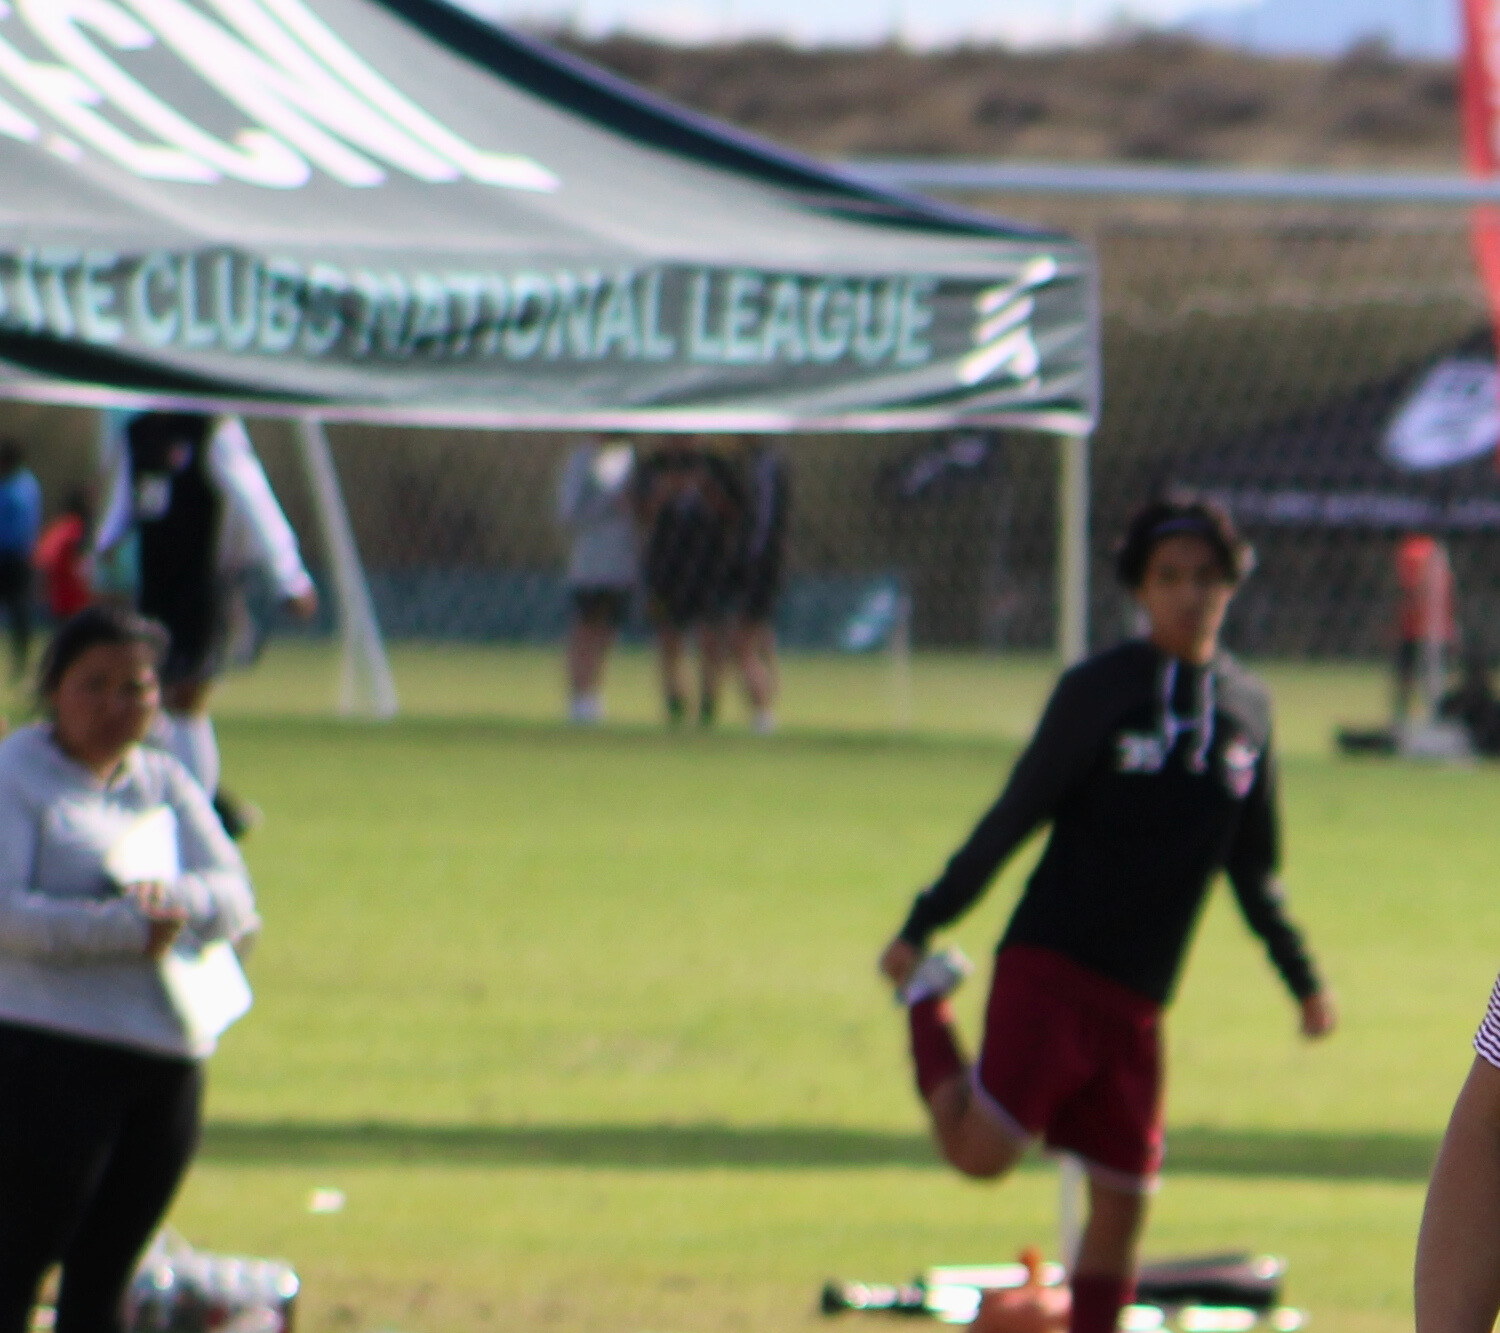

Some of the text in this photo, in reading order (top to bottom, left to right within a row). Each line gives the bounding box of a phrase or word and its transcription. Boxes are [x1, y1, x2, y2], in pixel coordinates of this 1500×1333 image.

[0, 247, 938, 366] ITE CLUBS NATIONAL LEAGUE
